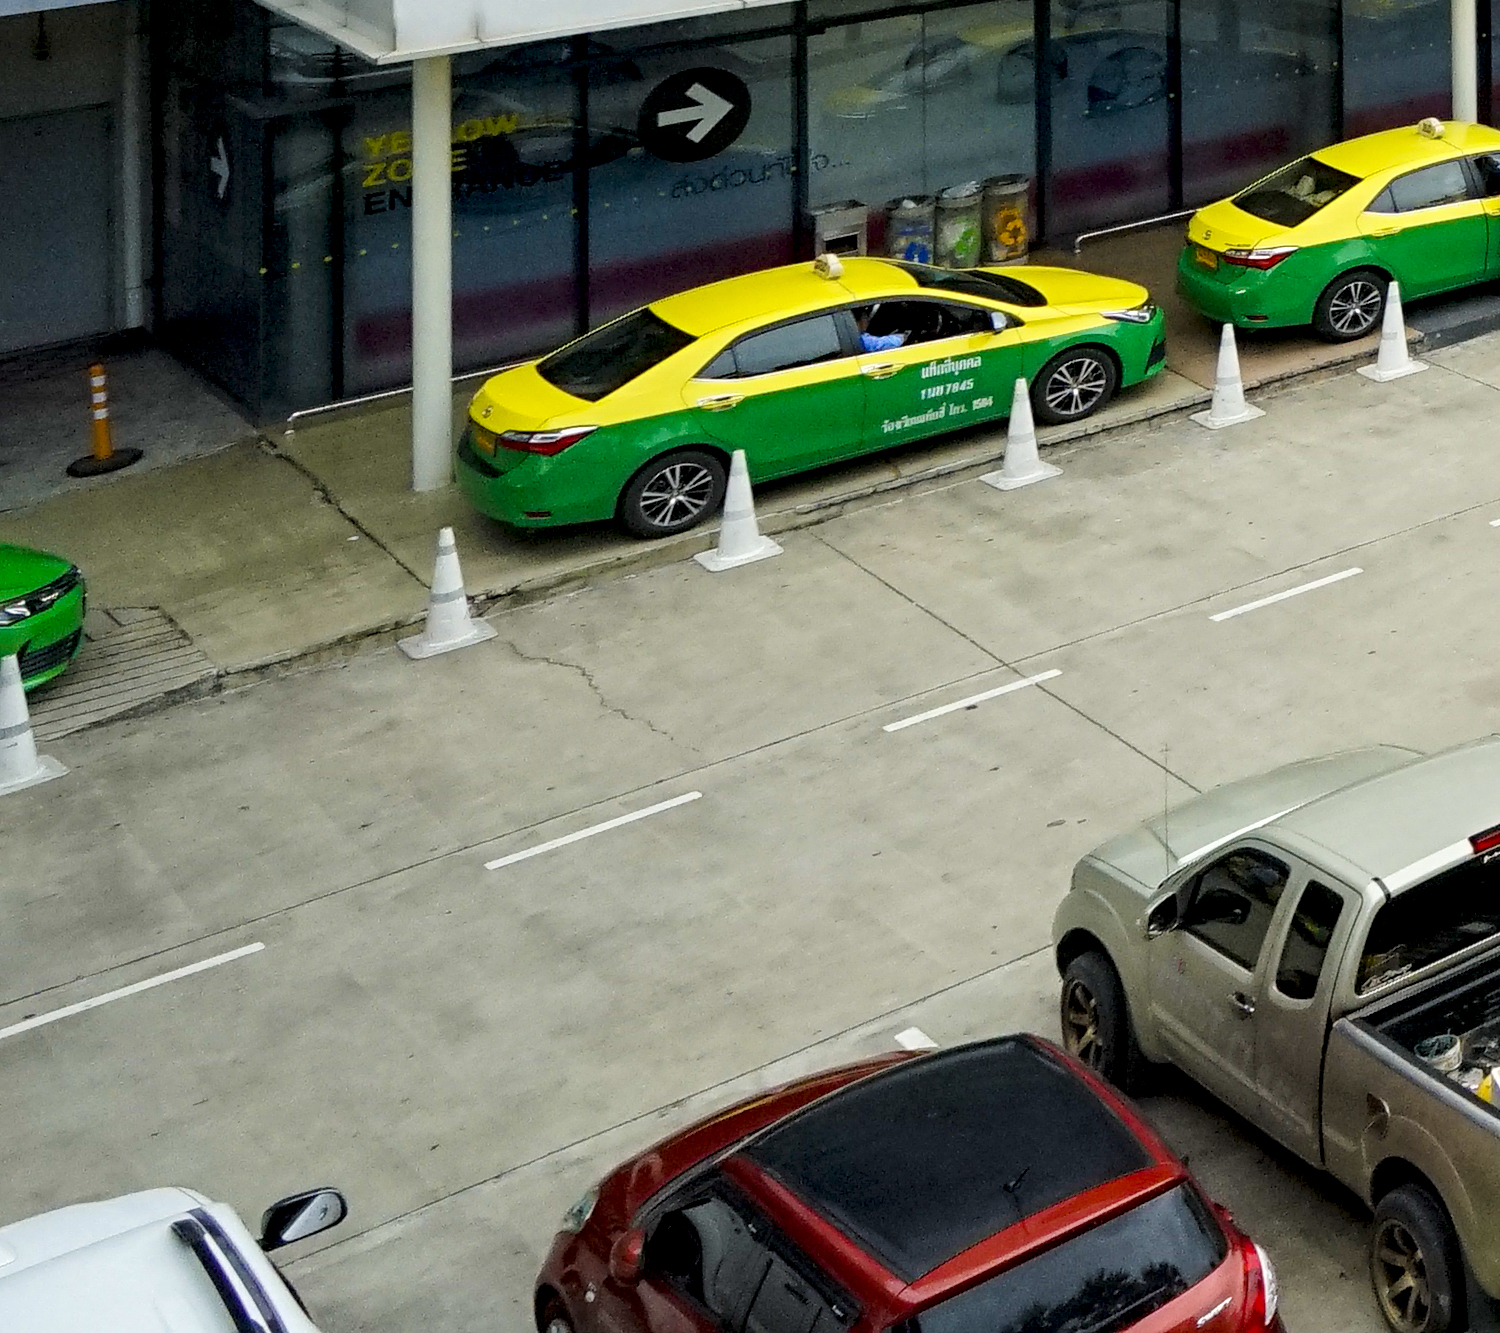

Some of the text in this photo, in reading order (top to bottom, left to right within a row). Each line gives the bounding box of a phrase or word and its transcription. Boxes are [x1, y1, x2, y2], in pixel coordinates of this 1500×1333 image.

[364, 113, 519, 156] YEOW
[362, 147, 468, 188] ZOE
[364, 159, 565, 216] ENANCE
